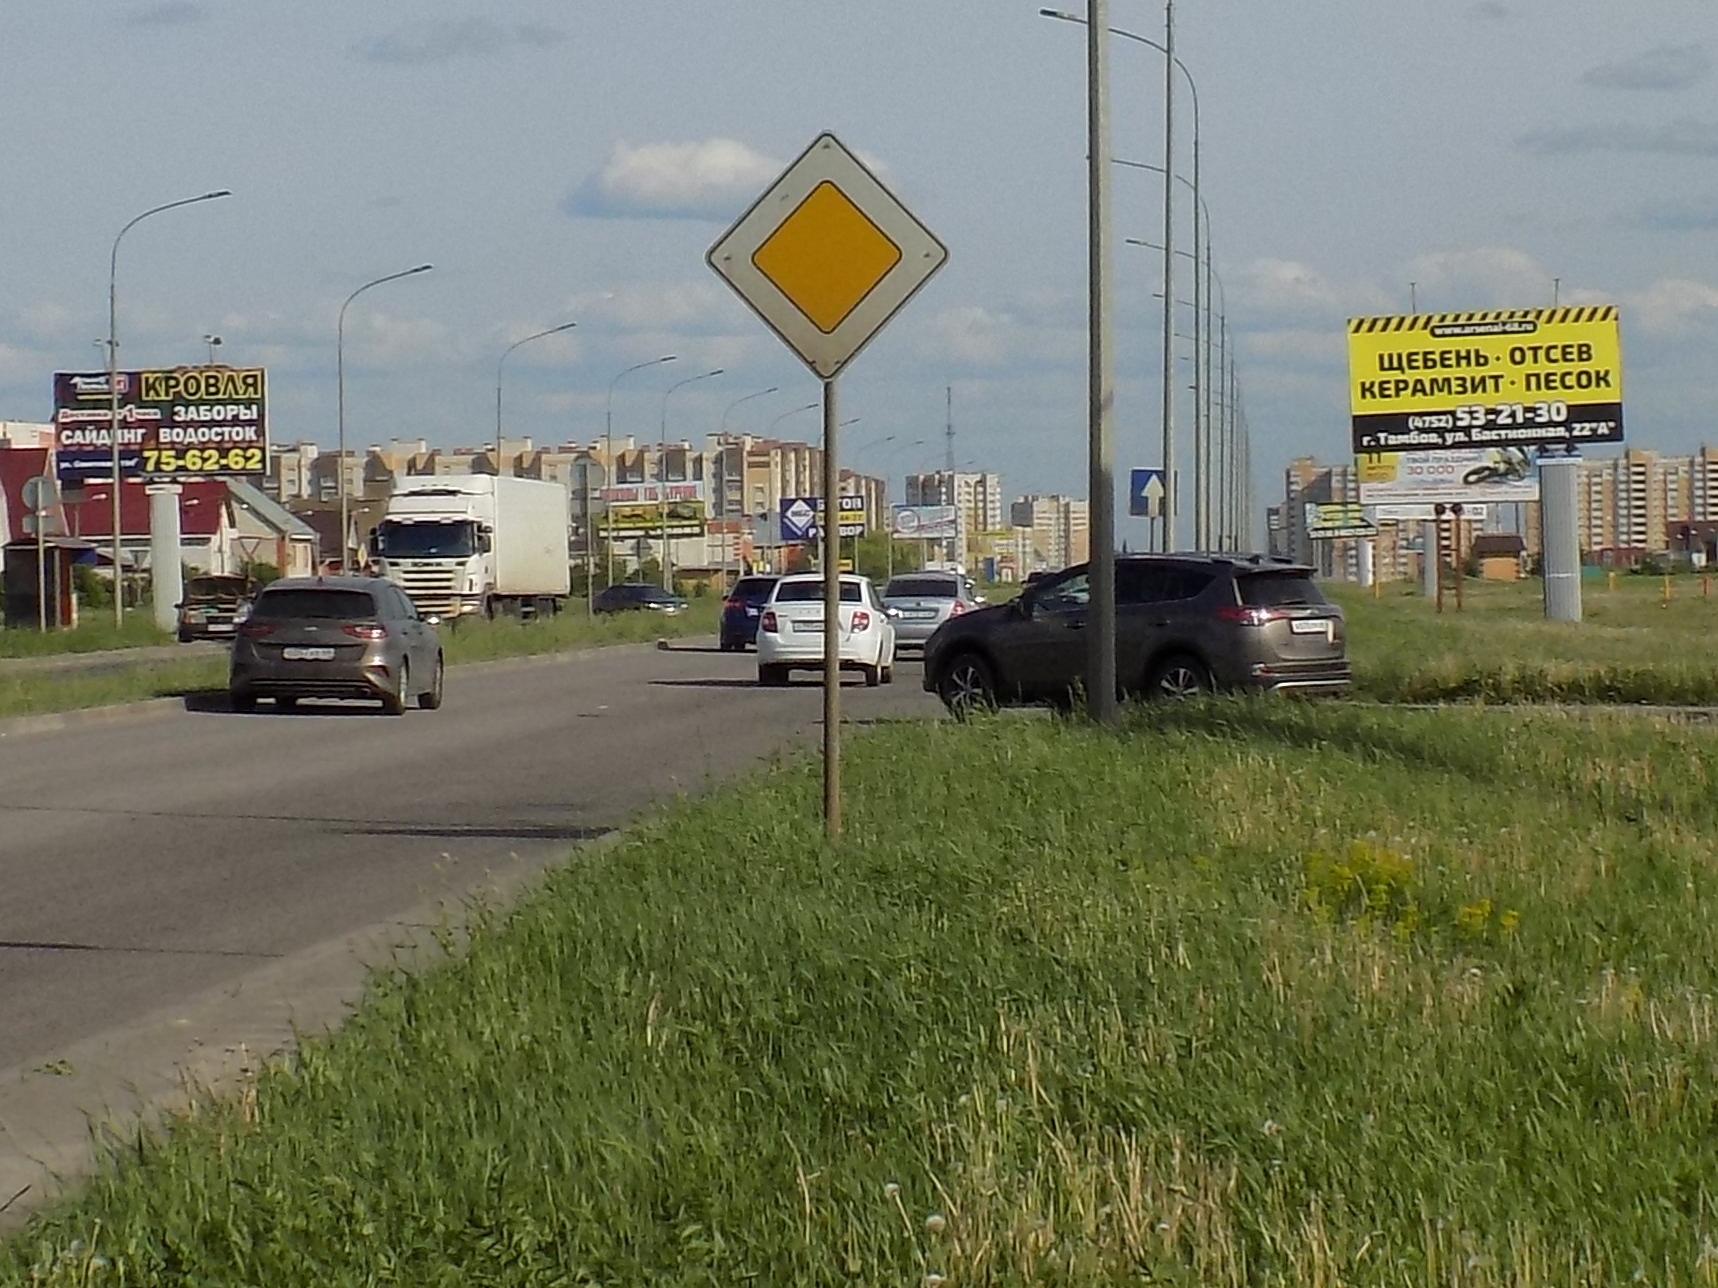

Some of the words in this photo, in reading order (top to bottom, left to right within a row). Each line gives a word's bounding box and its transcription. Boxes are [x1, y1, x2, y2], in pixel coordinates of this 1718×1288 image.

[1378, 349, 1489, 374] ЩЕБЕНЬ
[1509, 343, 1592, 366] ОТСЕВ
[142, 372, 262, 401] КРОВЛЯ
[1360, 375, 1504, 400] КЕРАМЗИТ
[1524, 369, 1612, 392] ПЕСОК
[173, 405, 258, 422] ЗАБОРЫ
[1408, 414, 1453, 430] (4752)
[1456, 402, 1568, 426] 53-21-30
[158, 425, 257, 444] ВОДОСТОК
[1362, 435, 1376, 446] г.
[1377, 431, 1443, 446] Тамбов,
[1444, 432, 1469, 445] ул.
[142, 448, 262, 472] 75-62-62
